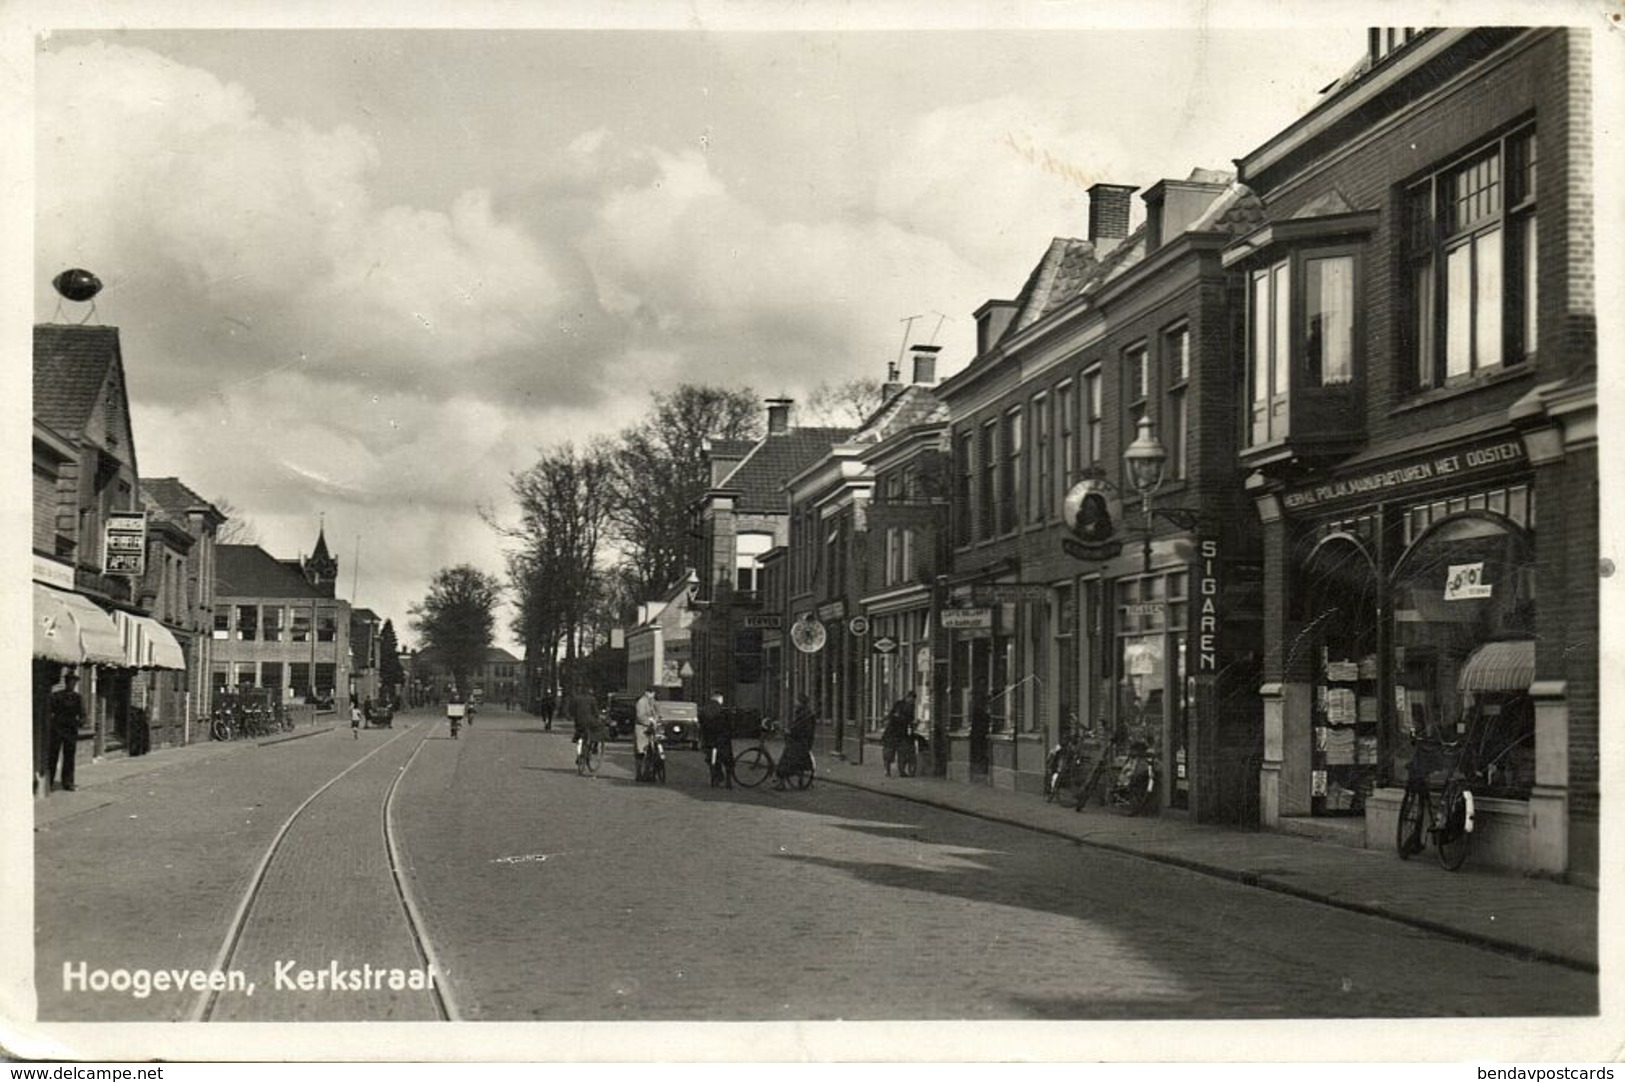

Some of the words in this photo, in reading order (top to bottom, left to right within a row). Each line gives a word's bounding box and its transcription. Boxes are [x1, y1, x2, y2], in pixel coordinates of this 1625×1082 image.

[1434, 455, 1460, 474] HET
[1466, 442, 1522, 467] OOSTEN
[1200, 540, 1217, 670] SIGAREN
